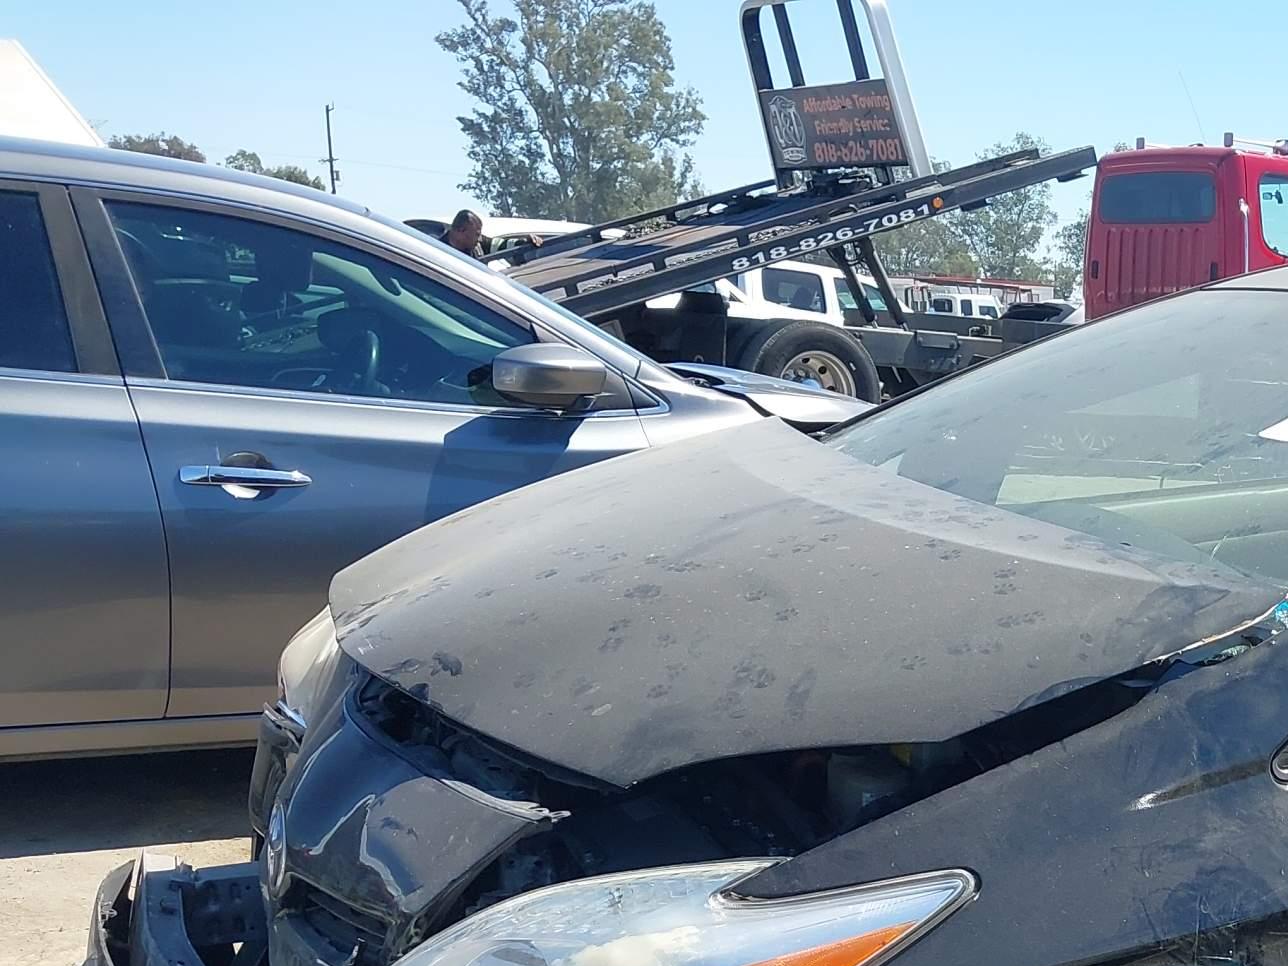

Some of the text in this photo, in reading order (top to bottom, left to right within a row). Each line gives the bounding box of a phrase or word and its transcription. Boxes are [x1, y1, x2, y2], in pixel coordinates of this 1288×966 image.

[803, 92, 891, 113] Affordable Towing
[814, 115, 891, 136] Friendly Service
[814, 138, 903, 163] 818-826-7081
[731, 203, 930, 271] 818-826-7081
